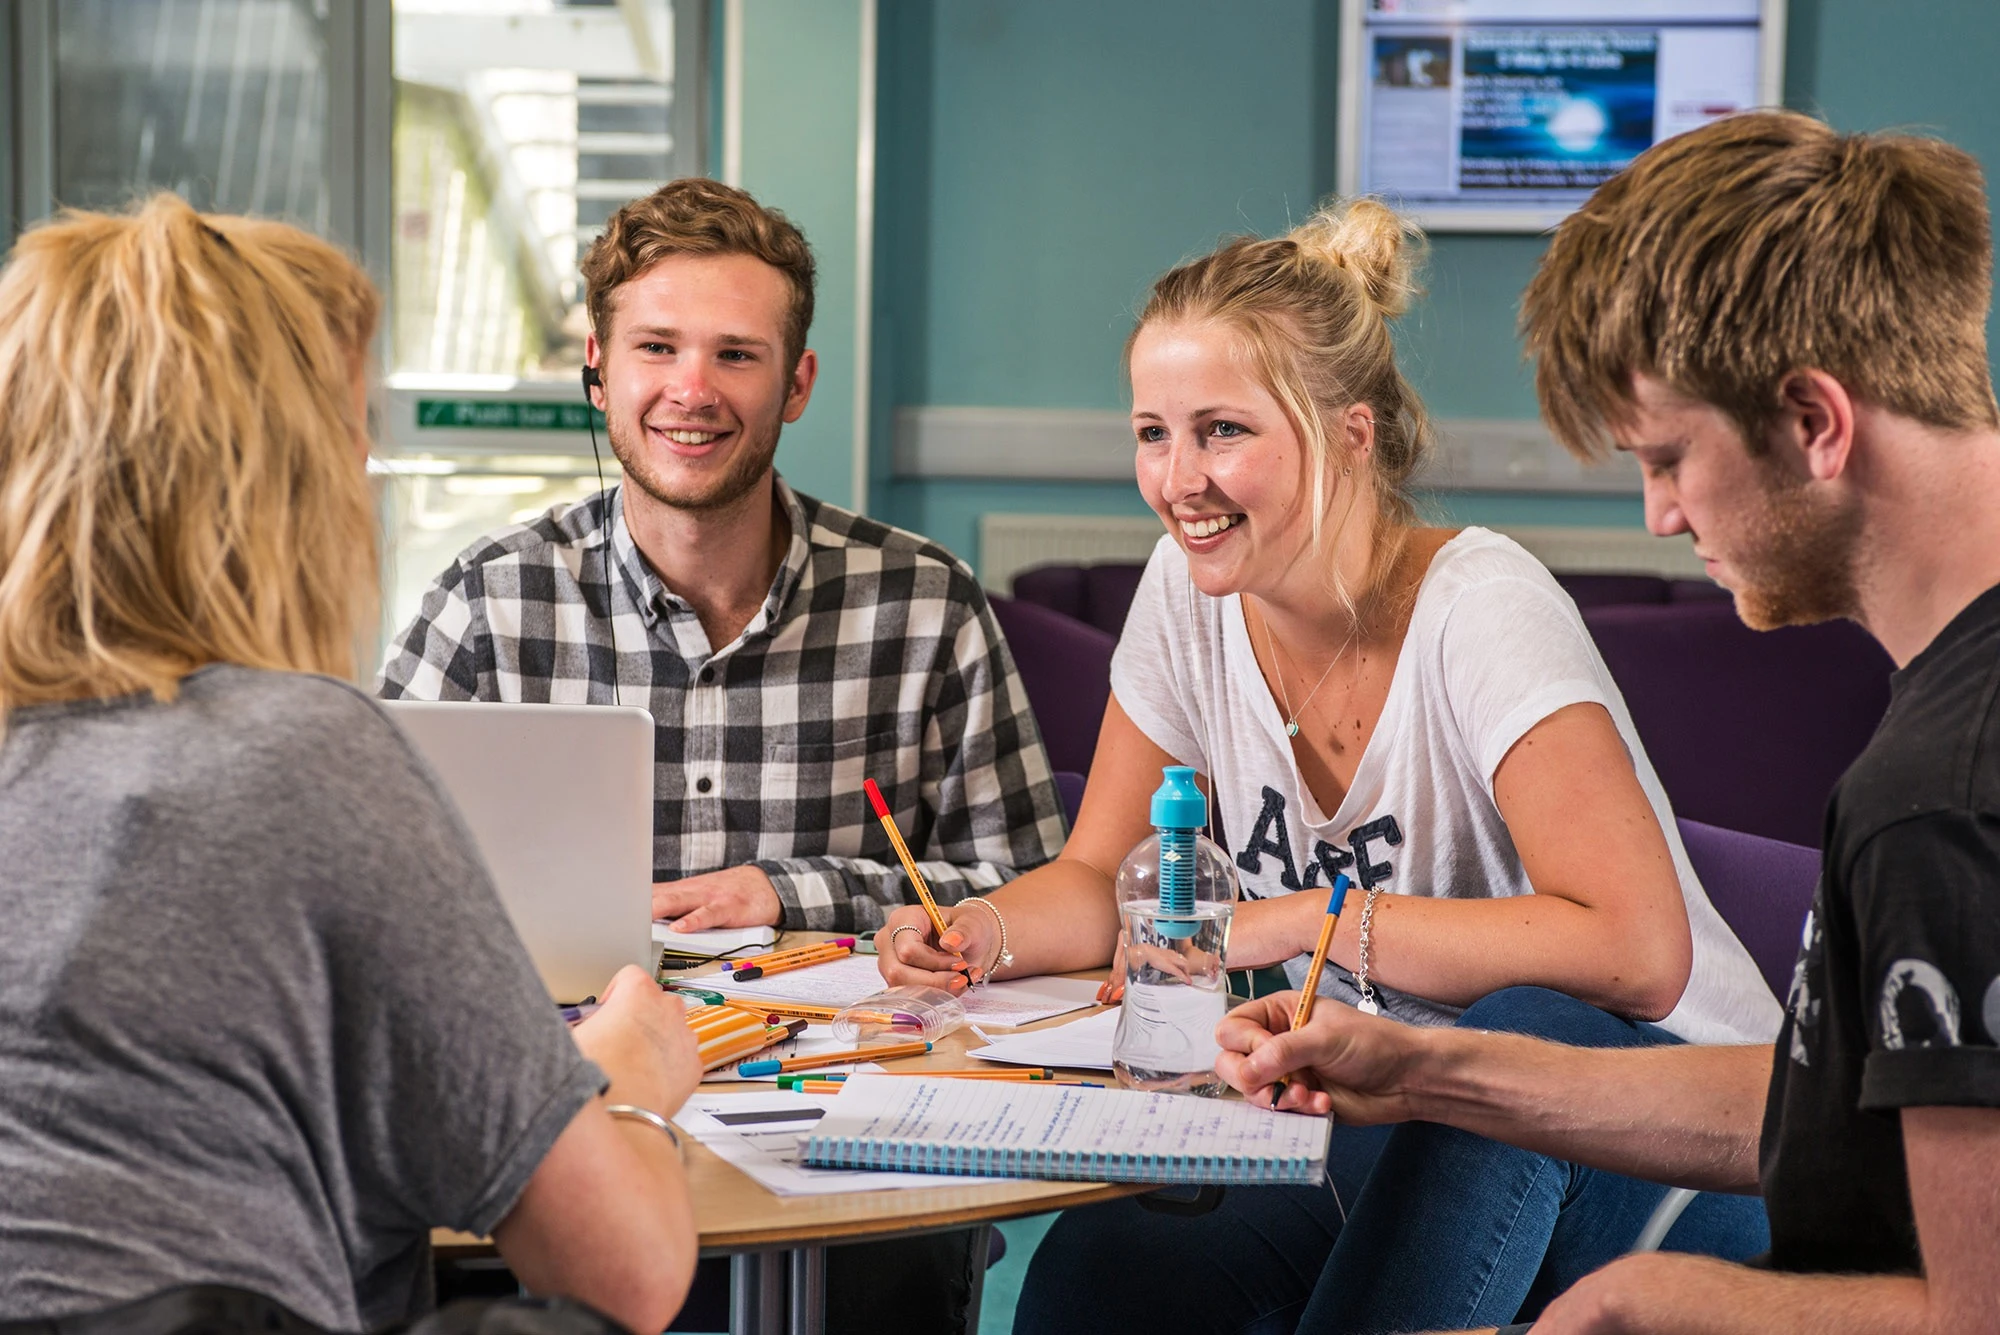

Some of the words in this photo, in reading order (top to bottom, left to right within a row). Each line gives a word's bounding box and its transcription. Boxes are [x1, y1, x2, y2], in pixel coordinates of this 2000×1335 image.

[454, 402, 513, 424] Push
[518, 403, 555, 424] bar
[560, 405, 586, 424] to
